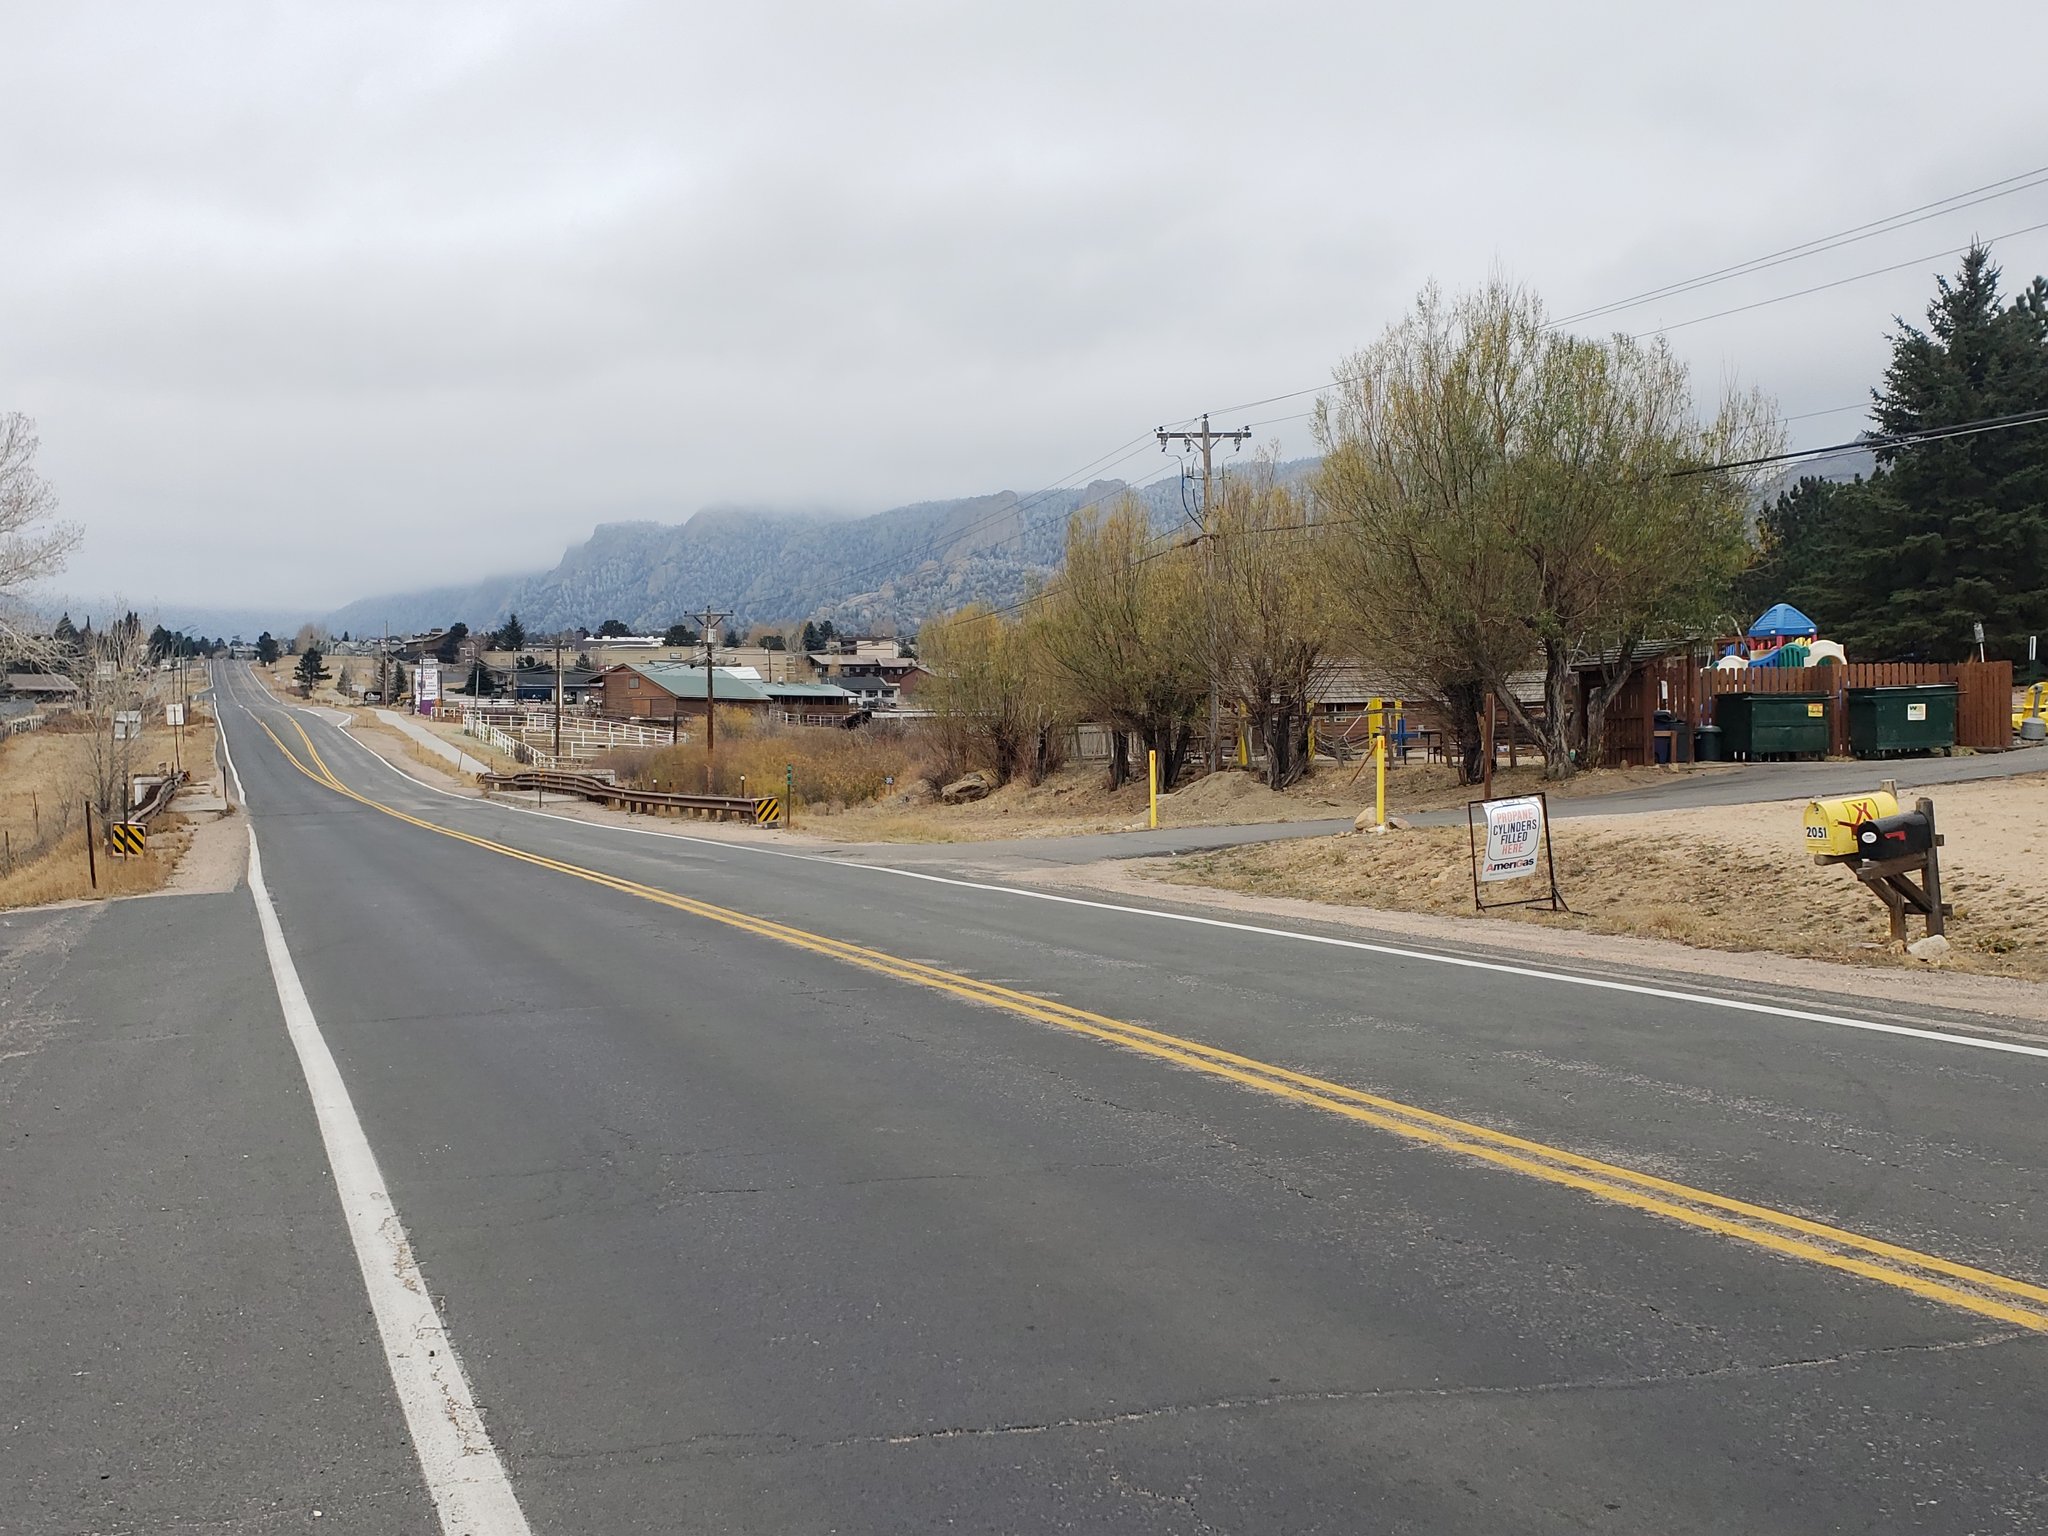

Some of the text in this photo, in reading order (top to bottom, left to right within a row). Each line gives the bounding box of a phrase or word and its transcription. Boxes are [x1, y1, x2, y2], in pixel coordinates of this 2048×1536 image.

[1497, 809, 1534, 823] PROPANE
[1493, 819, 1537, 836] CYLINDERS
[1806, 826, 1827, 839] 2051
[1500, 831, 1528, 845] FILLED
[1502, 843, 1524, 855] HERE
[1486, 858, 1534, 872] AmeriGas
